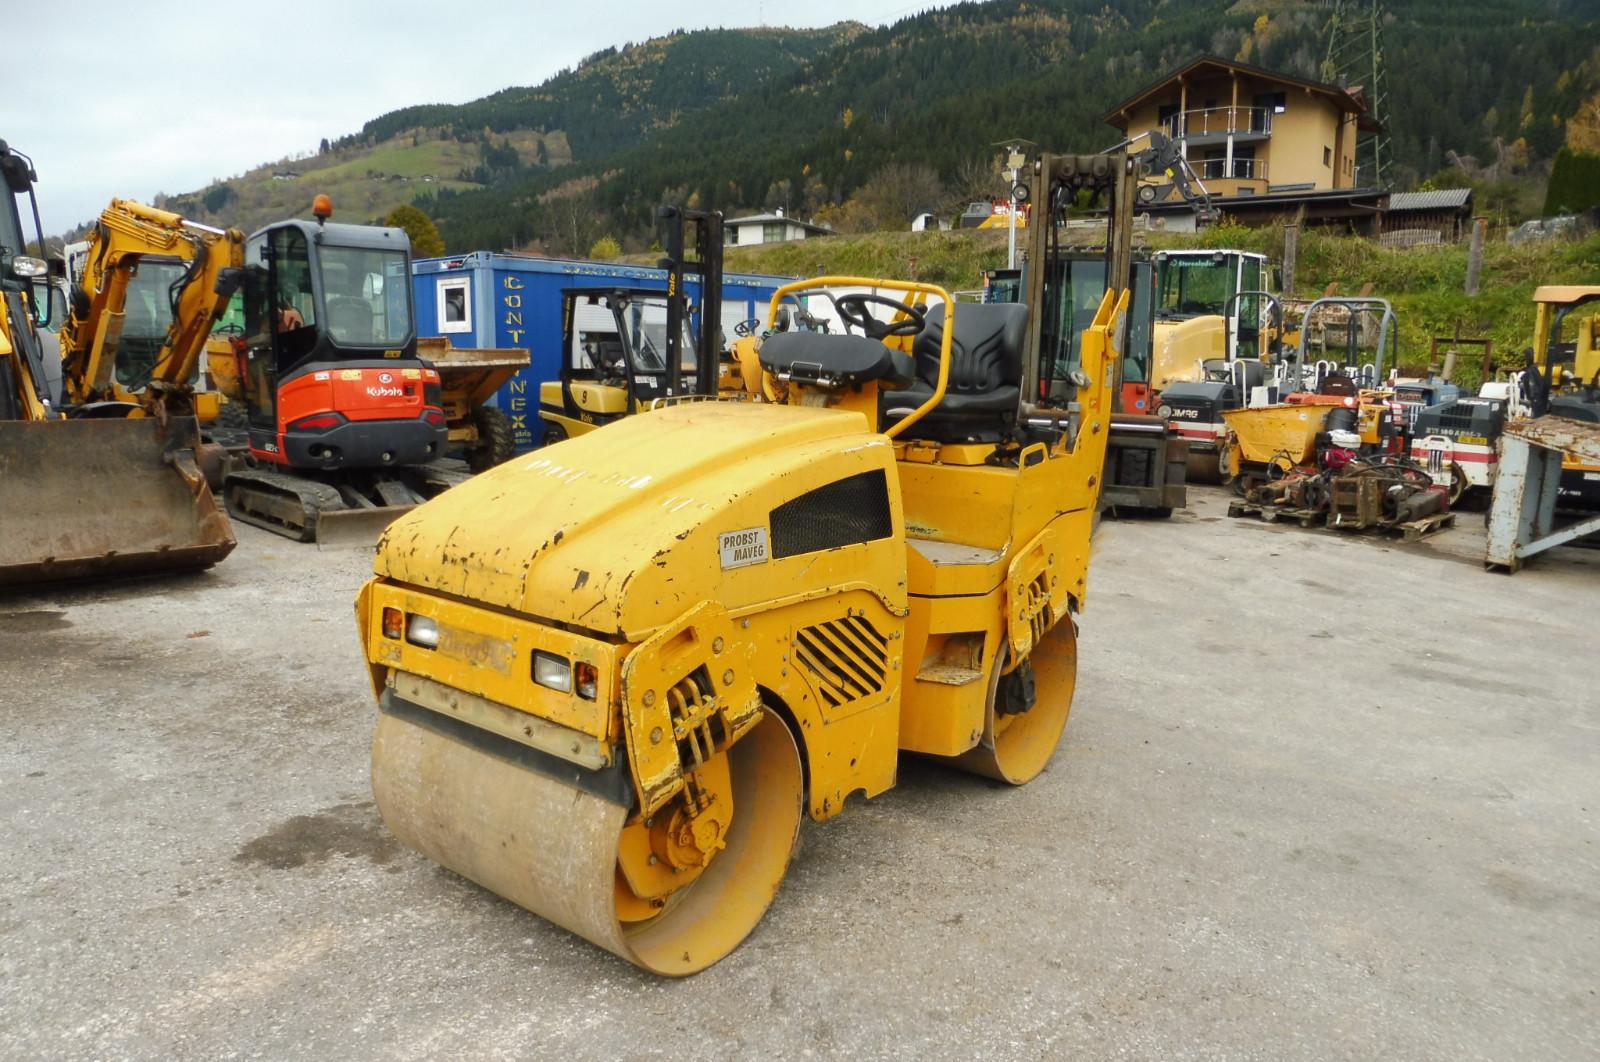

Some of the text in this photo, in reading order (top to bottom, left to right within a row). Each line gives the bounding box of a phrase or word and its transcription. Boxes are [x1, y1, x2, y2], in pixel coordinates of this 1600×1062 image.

[668, 272, 676, 297] Yale
[504, 276, 526, 428] CONTNEX
[366, 386, 403, 397] Kubota
[580, 412, 593, 424] Yale
[1171, 408, 1199, 418] OMAG
[724, 532, 764, 561] PROBST MAVEG
